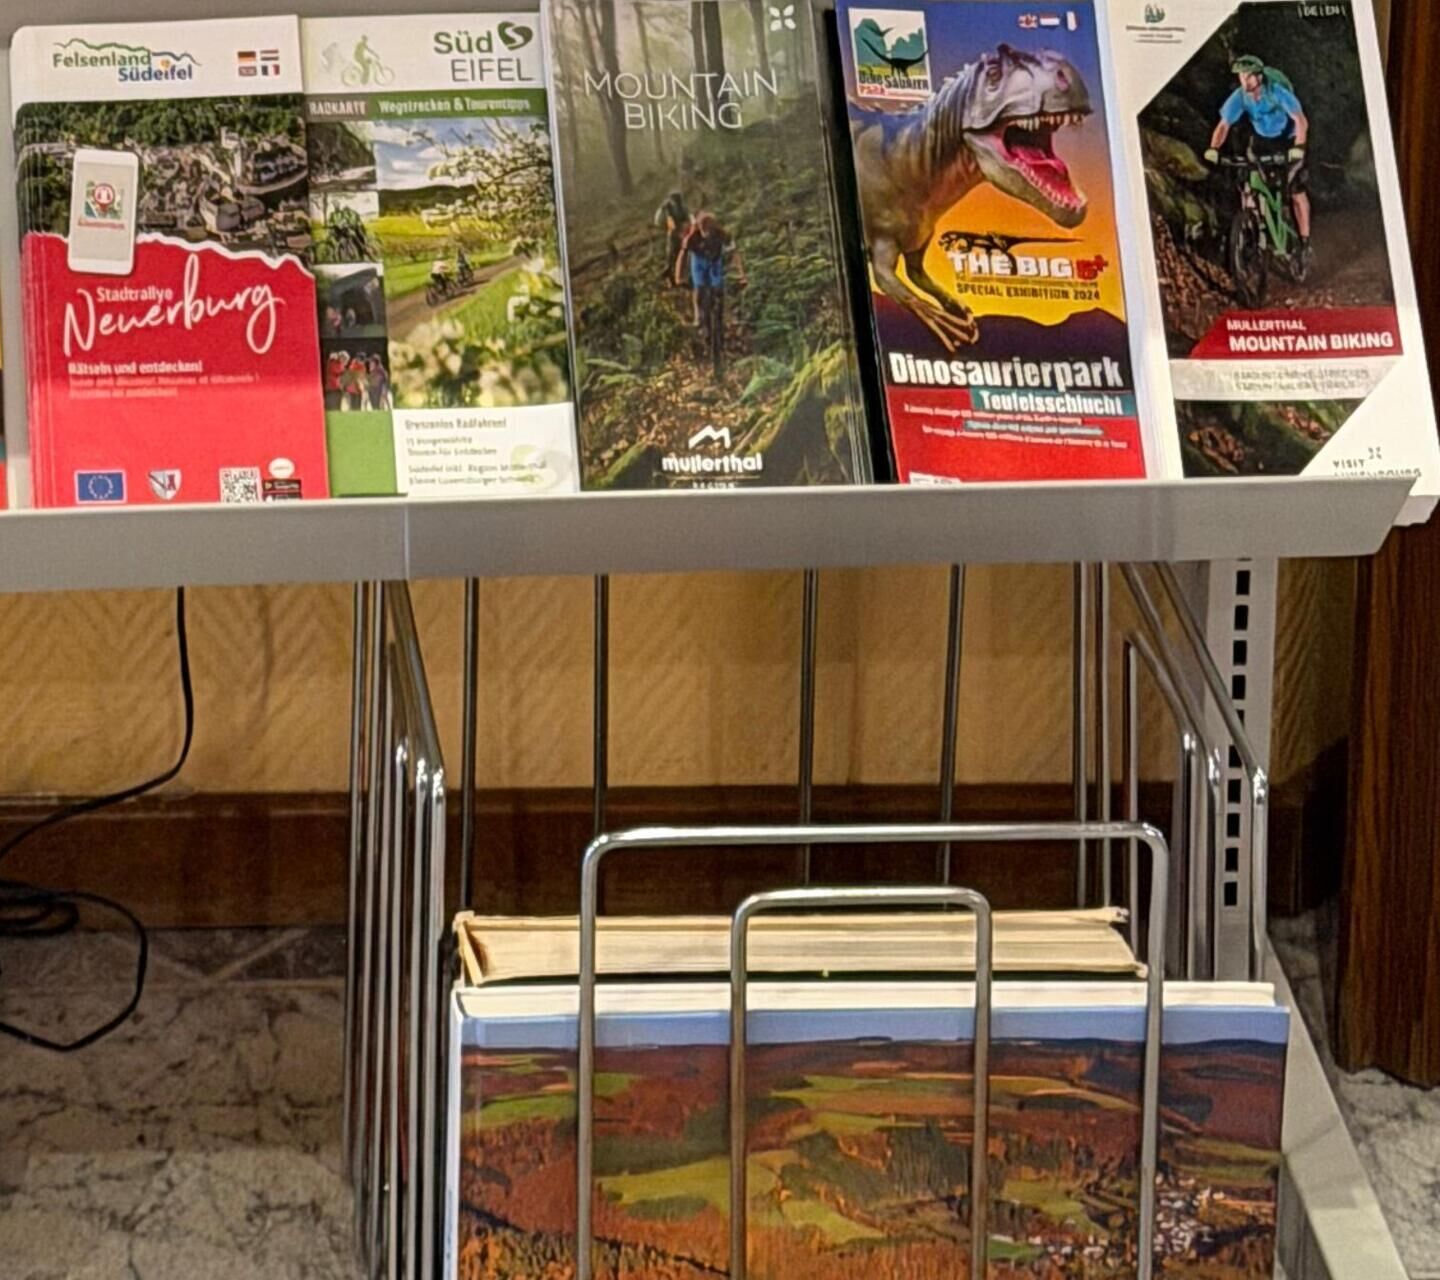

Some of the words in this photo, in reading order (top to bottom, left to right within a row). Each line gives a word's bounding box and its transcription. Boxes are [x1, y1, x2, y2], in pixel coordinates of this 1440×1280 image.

[433, 30, 494, 57] Süd
[52, 49, 152, 70] Felsenland
[451, 57, 534, 83] EIFEL
[117, 61, 194, 84] Südeifel
[583, 68, 779, 102] MOUNTAIN
[310, 99, 367, 117] RADKARTE
[377, 97, 452, 117] Wegstrecken
[453, 96, 465, 112] &
[465, 96, 532, 113] Tourentipps
[623, 101, 743, 131] BIKING
[946, 247, 1013, 277] THE
[1016, 256, 1074, 278] BIG
[96, 285, 174, 305] Stadtrallye
[956, 282, 1004, 298] SPECIAL
[1005, 285, 1071, 300] EXHIBITION
[1072, 289, 1101, 301] 2024
[62, 252, 286, 357] Neuerburg
[1226, 319, 1307, 332] MULLERTHAL
[1228, 333, 1329, 353] MOUNTAIN
[1330, 331, 1395, 351] BIKING
[113, 360, 138, 375] und
[138, 359, 204, 375] entdecken!
[888, 351, 1125, 392] Dinosaurierpark
[978, 389, 1125, 416] Teufelsschlucht
[661, 454, 763, 474] mullerthal
[1332, 458, 1366, 470] VISIT
